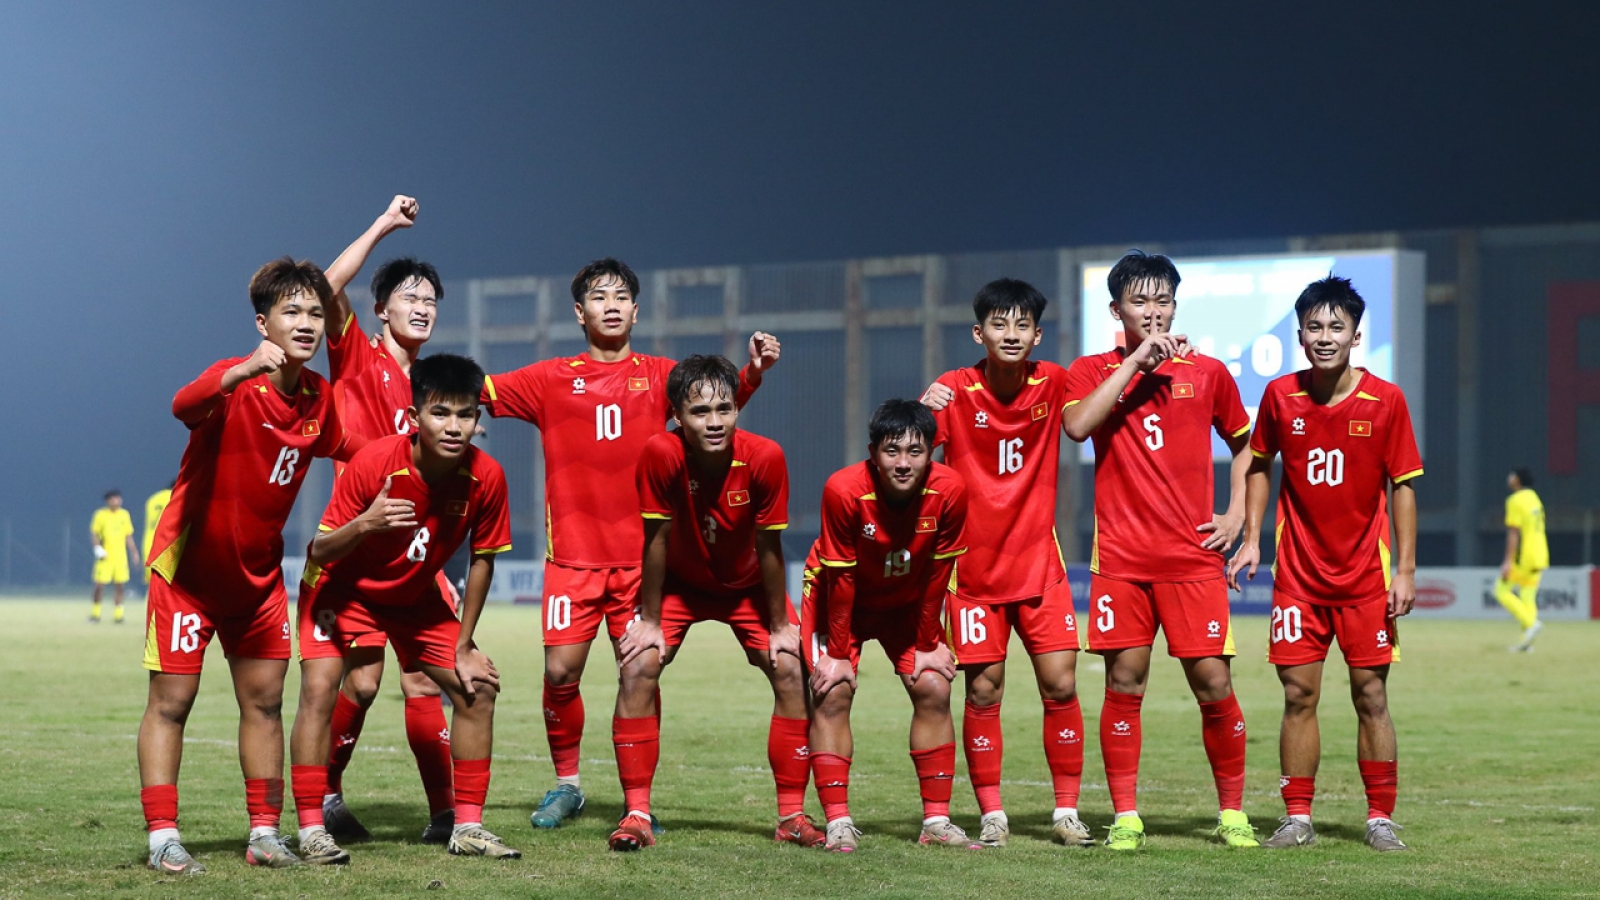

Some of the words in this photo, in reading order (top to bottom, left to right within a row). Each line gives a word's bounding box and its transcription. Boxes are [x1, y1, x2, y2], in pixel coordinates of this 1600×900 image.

[595, 403, 622, 441] 10
[1143, 413, 1164, 452] 5
[269, 446, 300, 487] 13
[998, 437, 1024, 475] 16
[1307, 447, 1345, 487] 20
[406, 526, 430, 562] 8
[884, 548, 911, 578] 19
[170, 611, 202, 654] 13
[312, 609, 337, 642] 8
[547, 594, 572, 632] 10
[959, 605, 987, 646] 16
[1096, 594, 1115, 633] 5
[1271, 604, 1302, 644] 20
